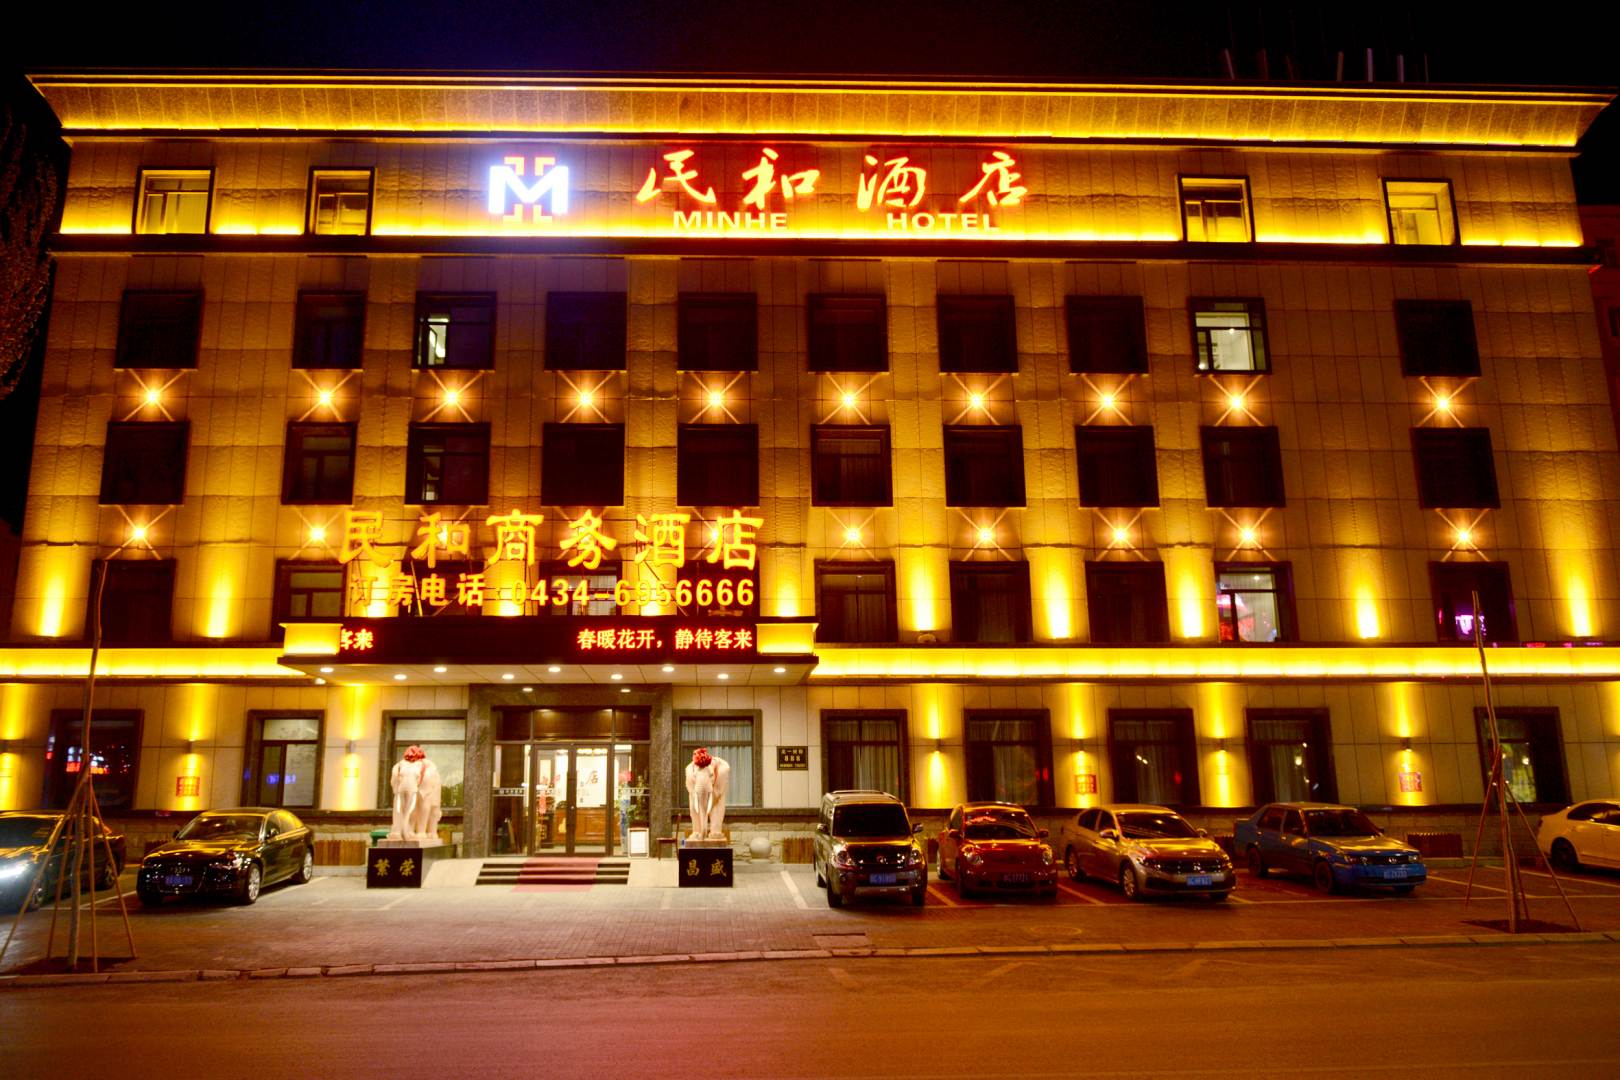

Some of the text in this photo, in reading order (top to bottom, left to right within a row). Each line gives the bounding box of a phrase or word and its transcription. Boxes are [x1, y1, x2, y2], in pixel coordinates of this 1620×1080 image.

[672, 210, 1001, 232] MINHE HOTEL
[338, 509, 764, 570] 民和商务酒店
